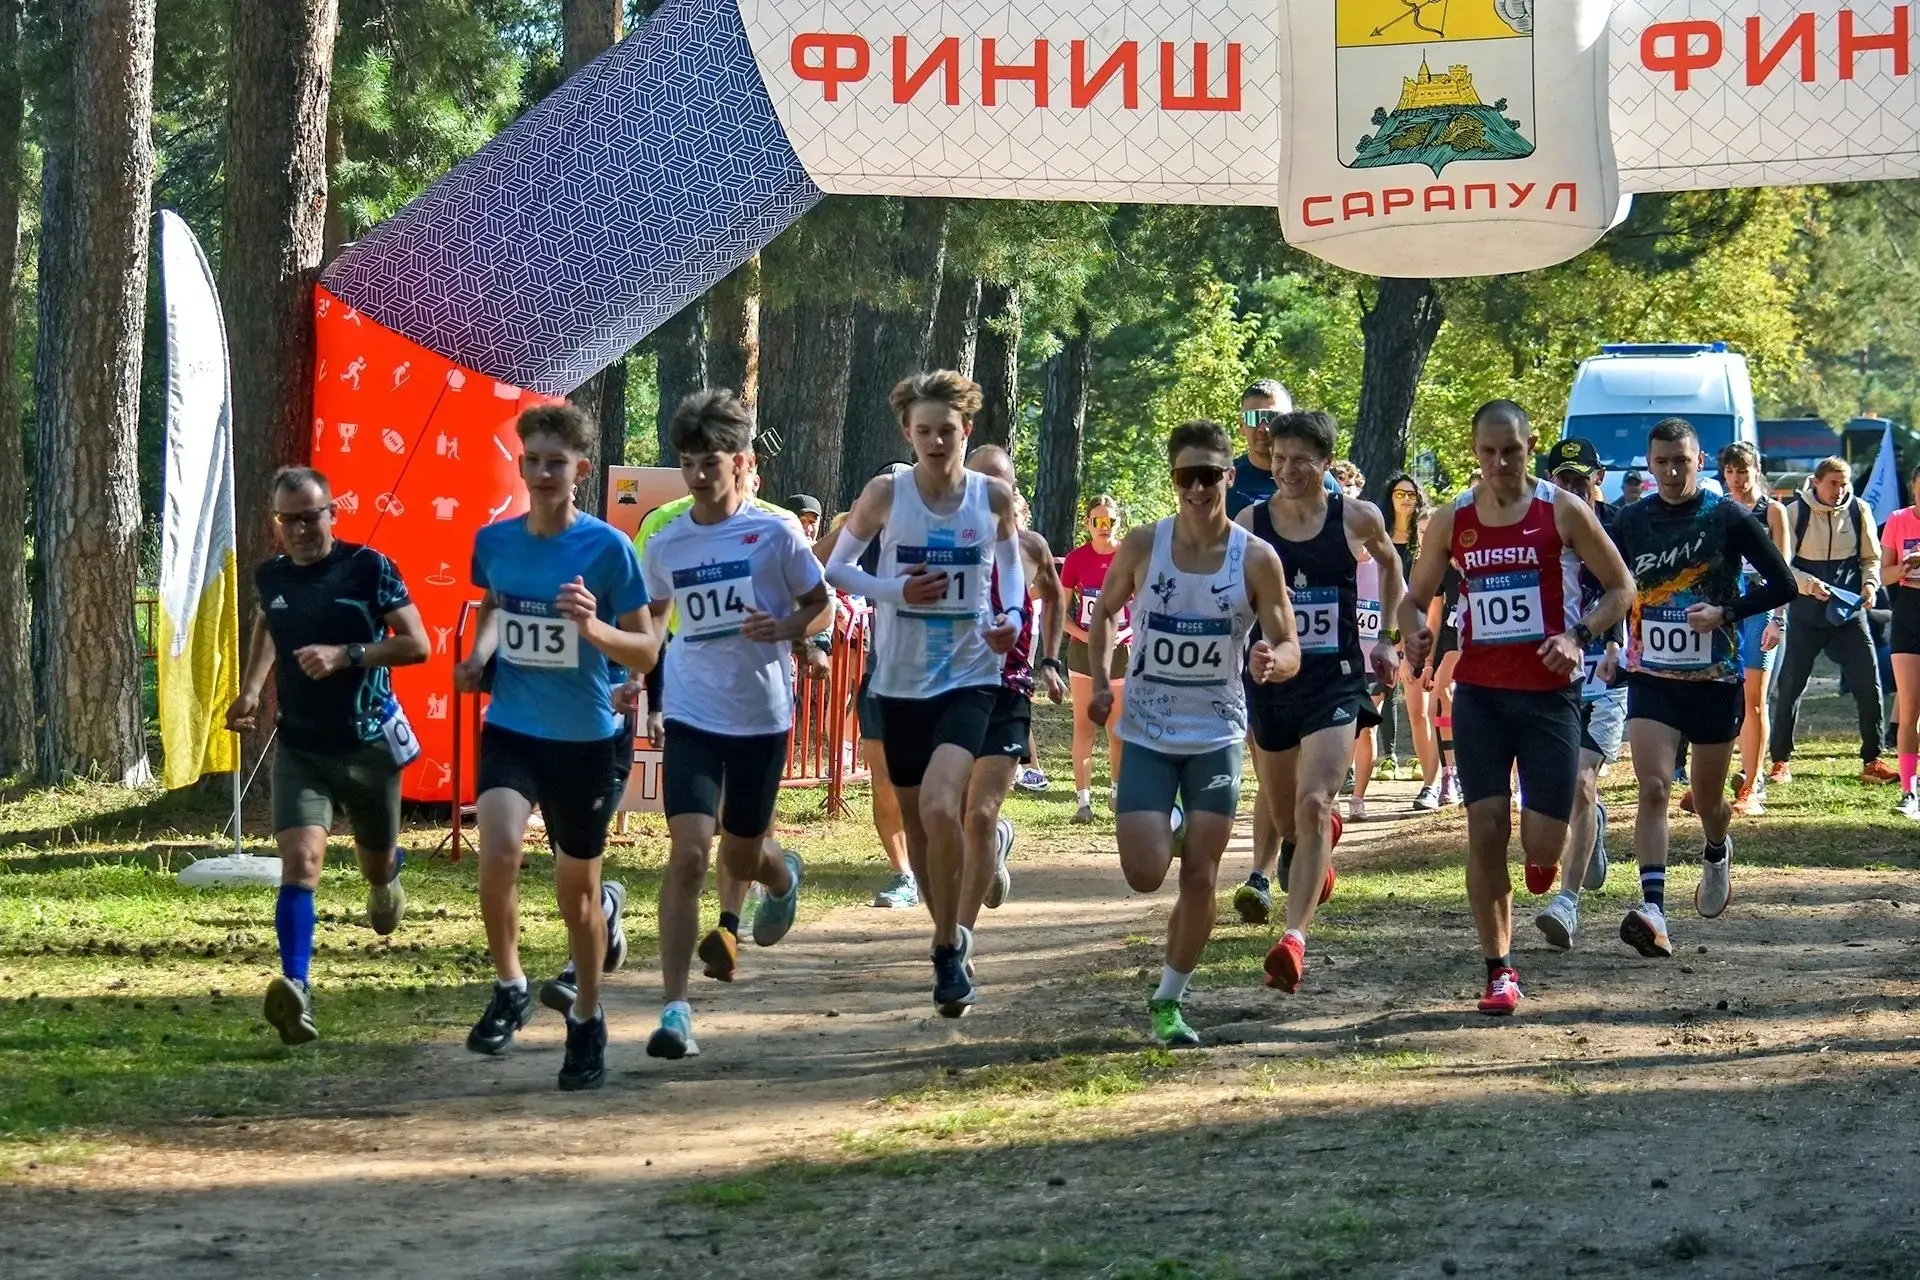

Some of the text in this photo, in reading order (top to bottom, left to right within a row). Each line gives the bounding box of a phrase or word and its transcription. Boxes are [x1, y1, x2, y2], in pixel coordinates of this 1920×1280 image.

[790, 32, 1242, 112] ФИНИШ
[1302, 182, 1578, 227] САРАПУЛ
[1464, 546, 1540, 570] RUSSIA
[686, 585, 744, 621] 014
[1476, 594, 1531, 626] 105
[506, 620, 566, 654] 013
[1293, 609, 1331, 637] 05
[1357, 612, 1378, 630] 40
[1153, 637, 1222, 669] 004
[1650, 627, 1701, 652] 001
